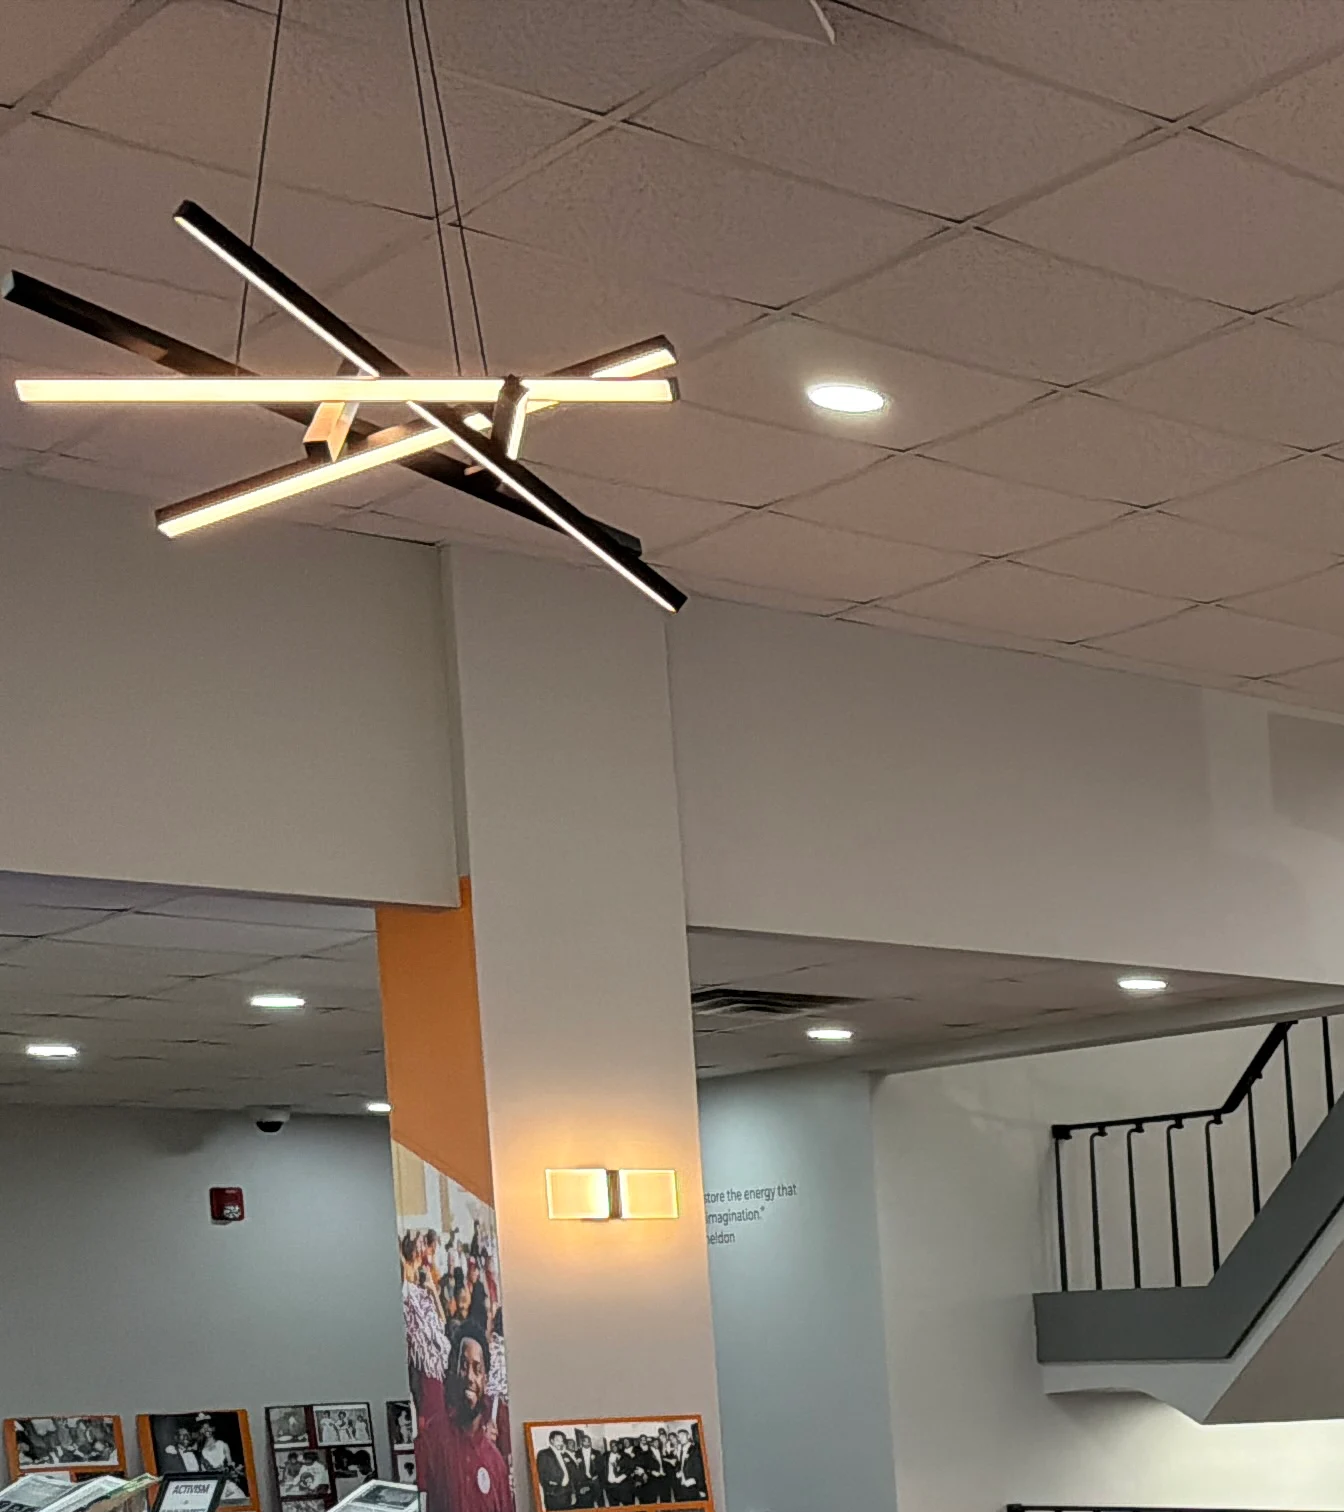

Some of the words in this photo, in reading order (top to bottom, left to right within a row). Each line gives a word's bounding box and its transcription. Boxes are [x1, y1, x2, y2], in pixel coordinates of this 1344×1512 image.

[726, 1188, 742, 1202] the
[743, 1186, 776, 1202] energy
[776, 1184, 797, 1198] that
[172, 1484, 211, 1495] ACTIVISM
